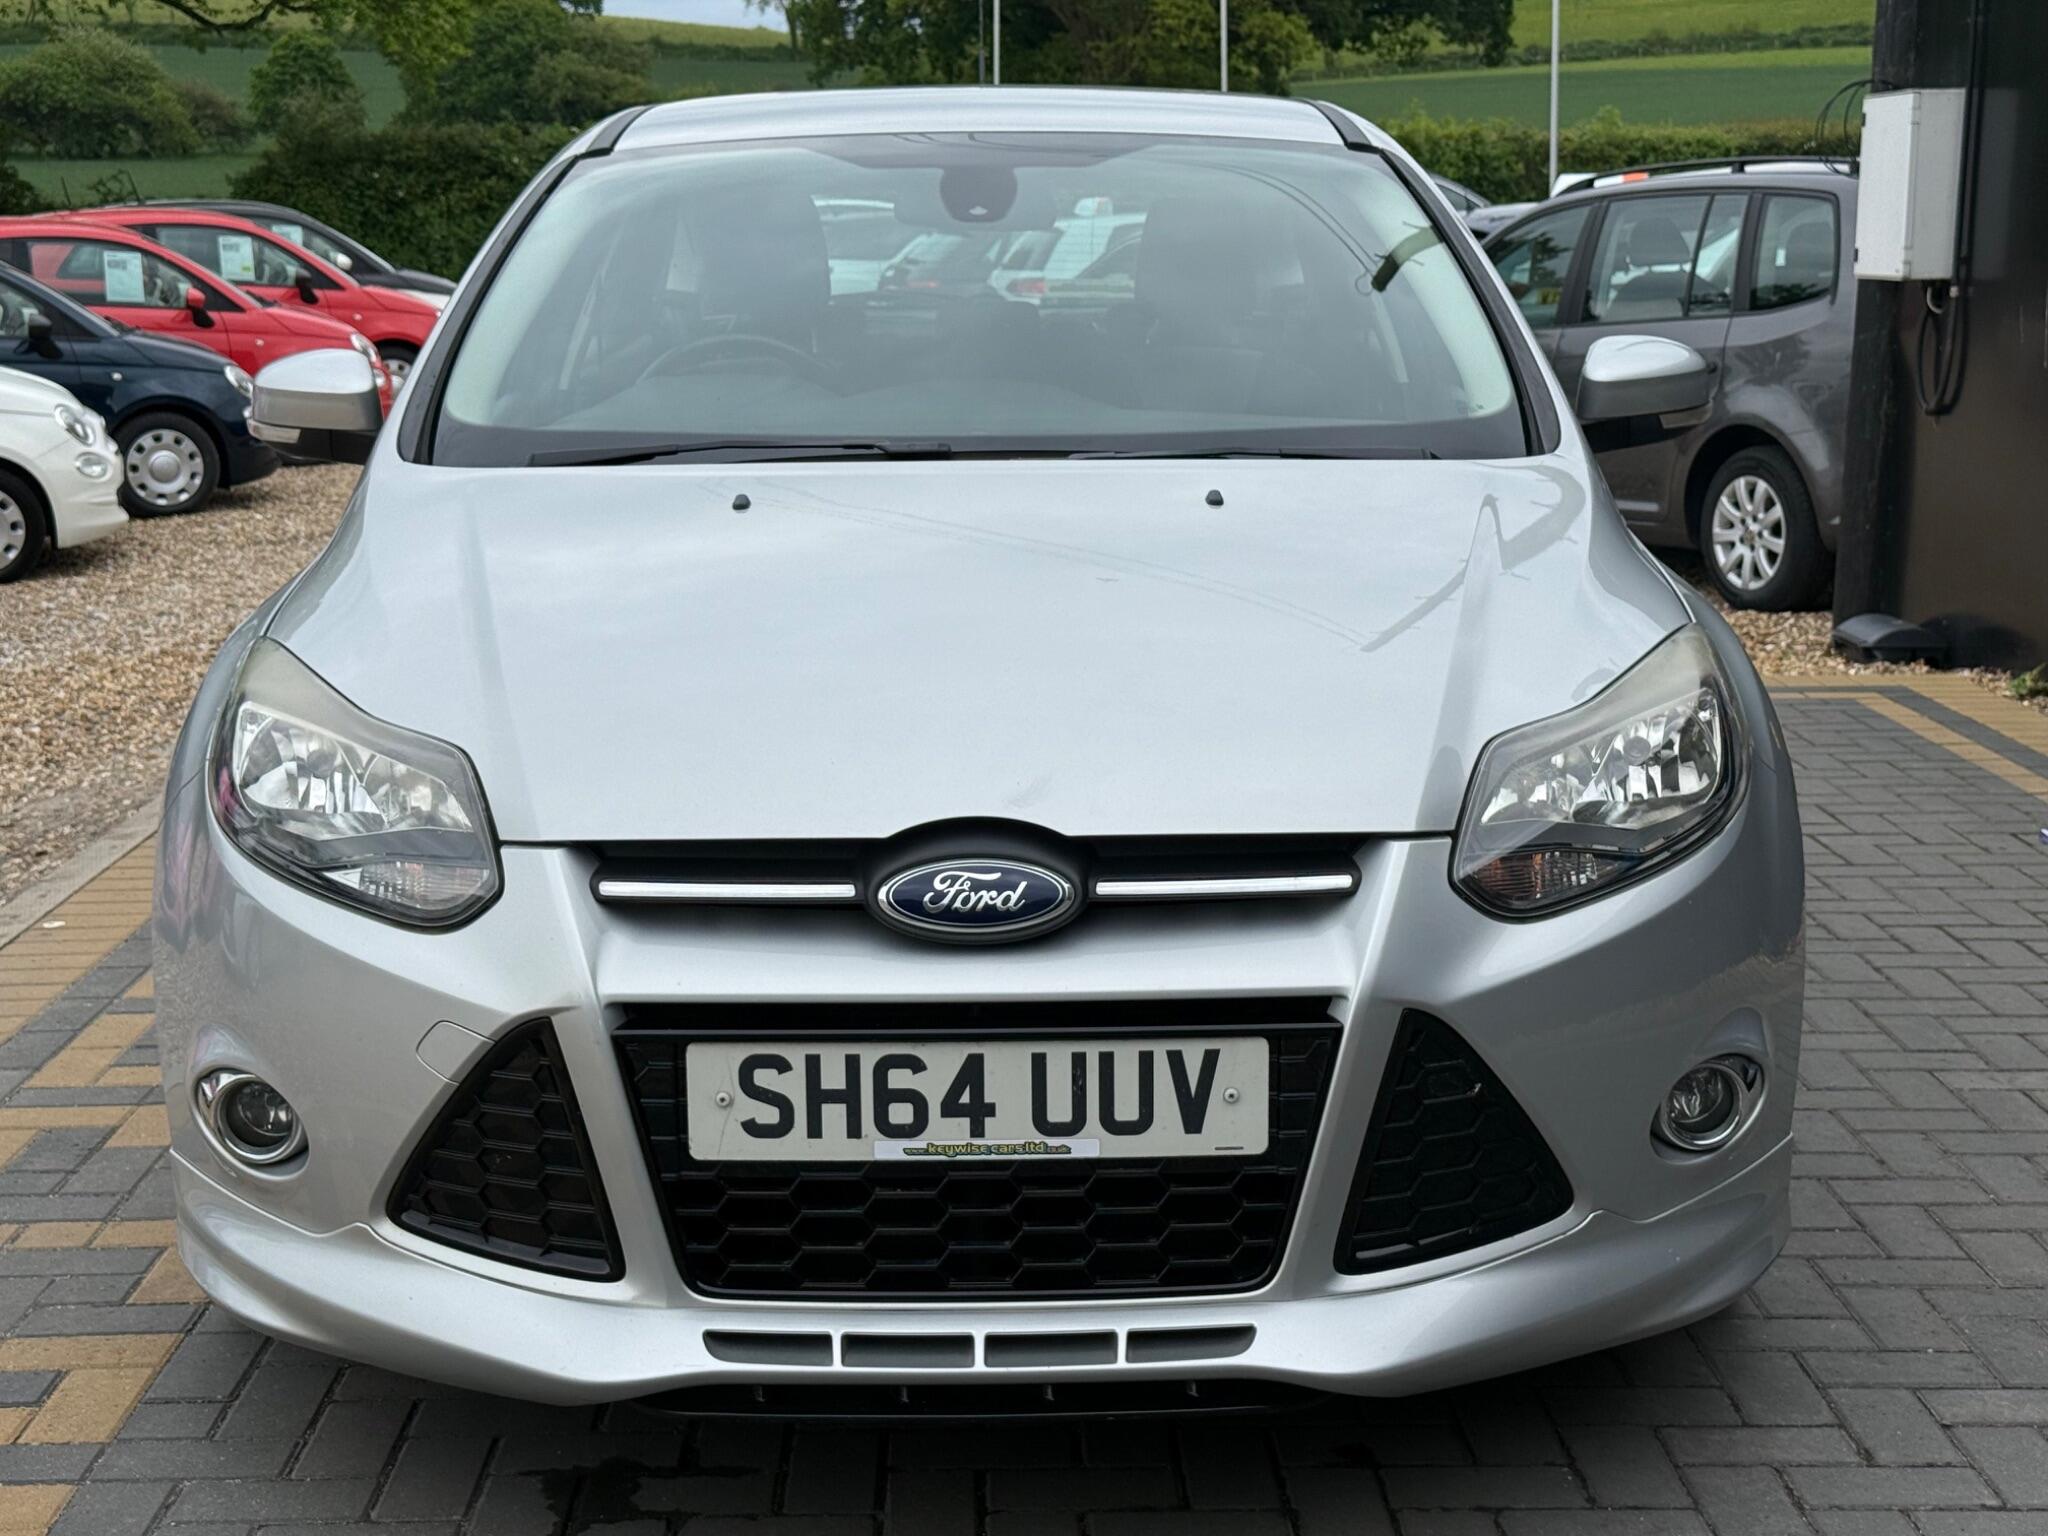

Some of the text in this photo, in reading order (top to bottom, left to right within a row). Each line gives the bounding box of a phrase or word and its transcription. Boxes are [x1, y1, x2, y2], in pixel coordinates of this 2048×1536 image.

[923, 870, 1028, 913] Ford
[738, 1048, 1220, 1139] SH64 UUV
